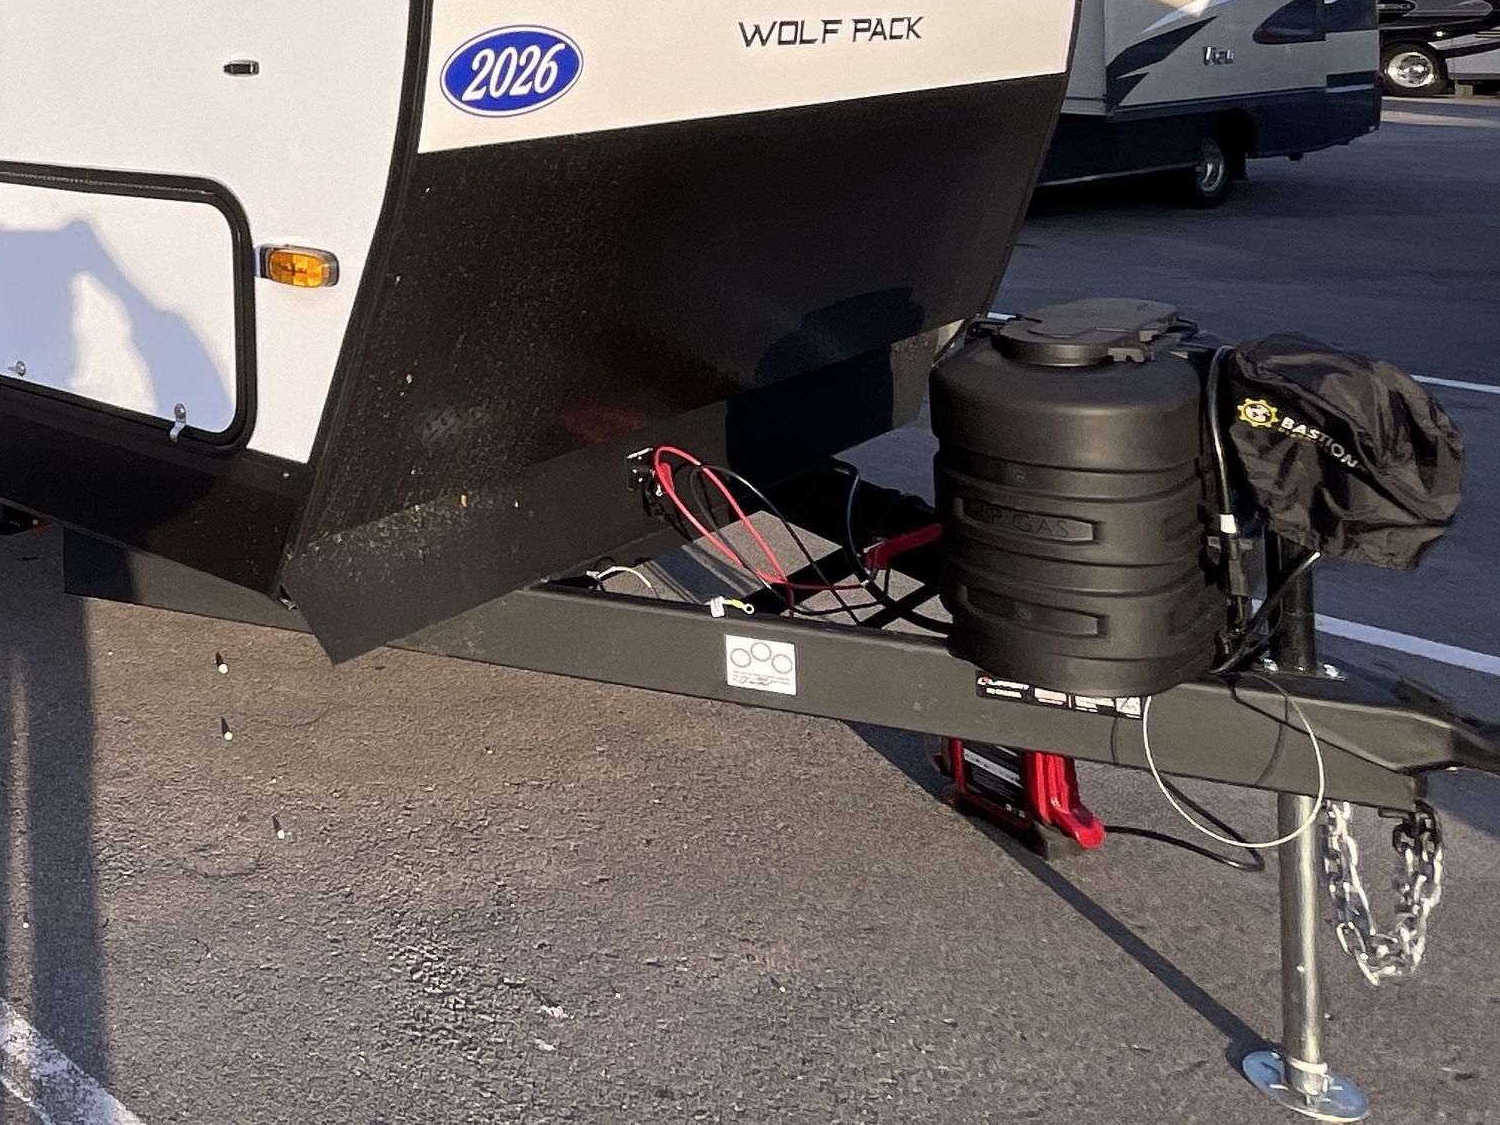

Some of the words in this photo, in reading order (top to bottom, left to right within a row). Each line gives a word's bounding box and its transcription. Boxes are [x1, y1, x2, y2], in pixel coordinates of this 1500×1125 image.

[739, 19, 843, 47] WOLF
[852, 16, 924, 42] PACK
[461, 43, 566, 101] 2026
[1280, 416, 1359, 468] BASTION
[1011, 513, 1069, 539] GAS
